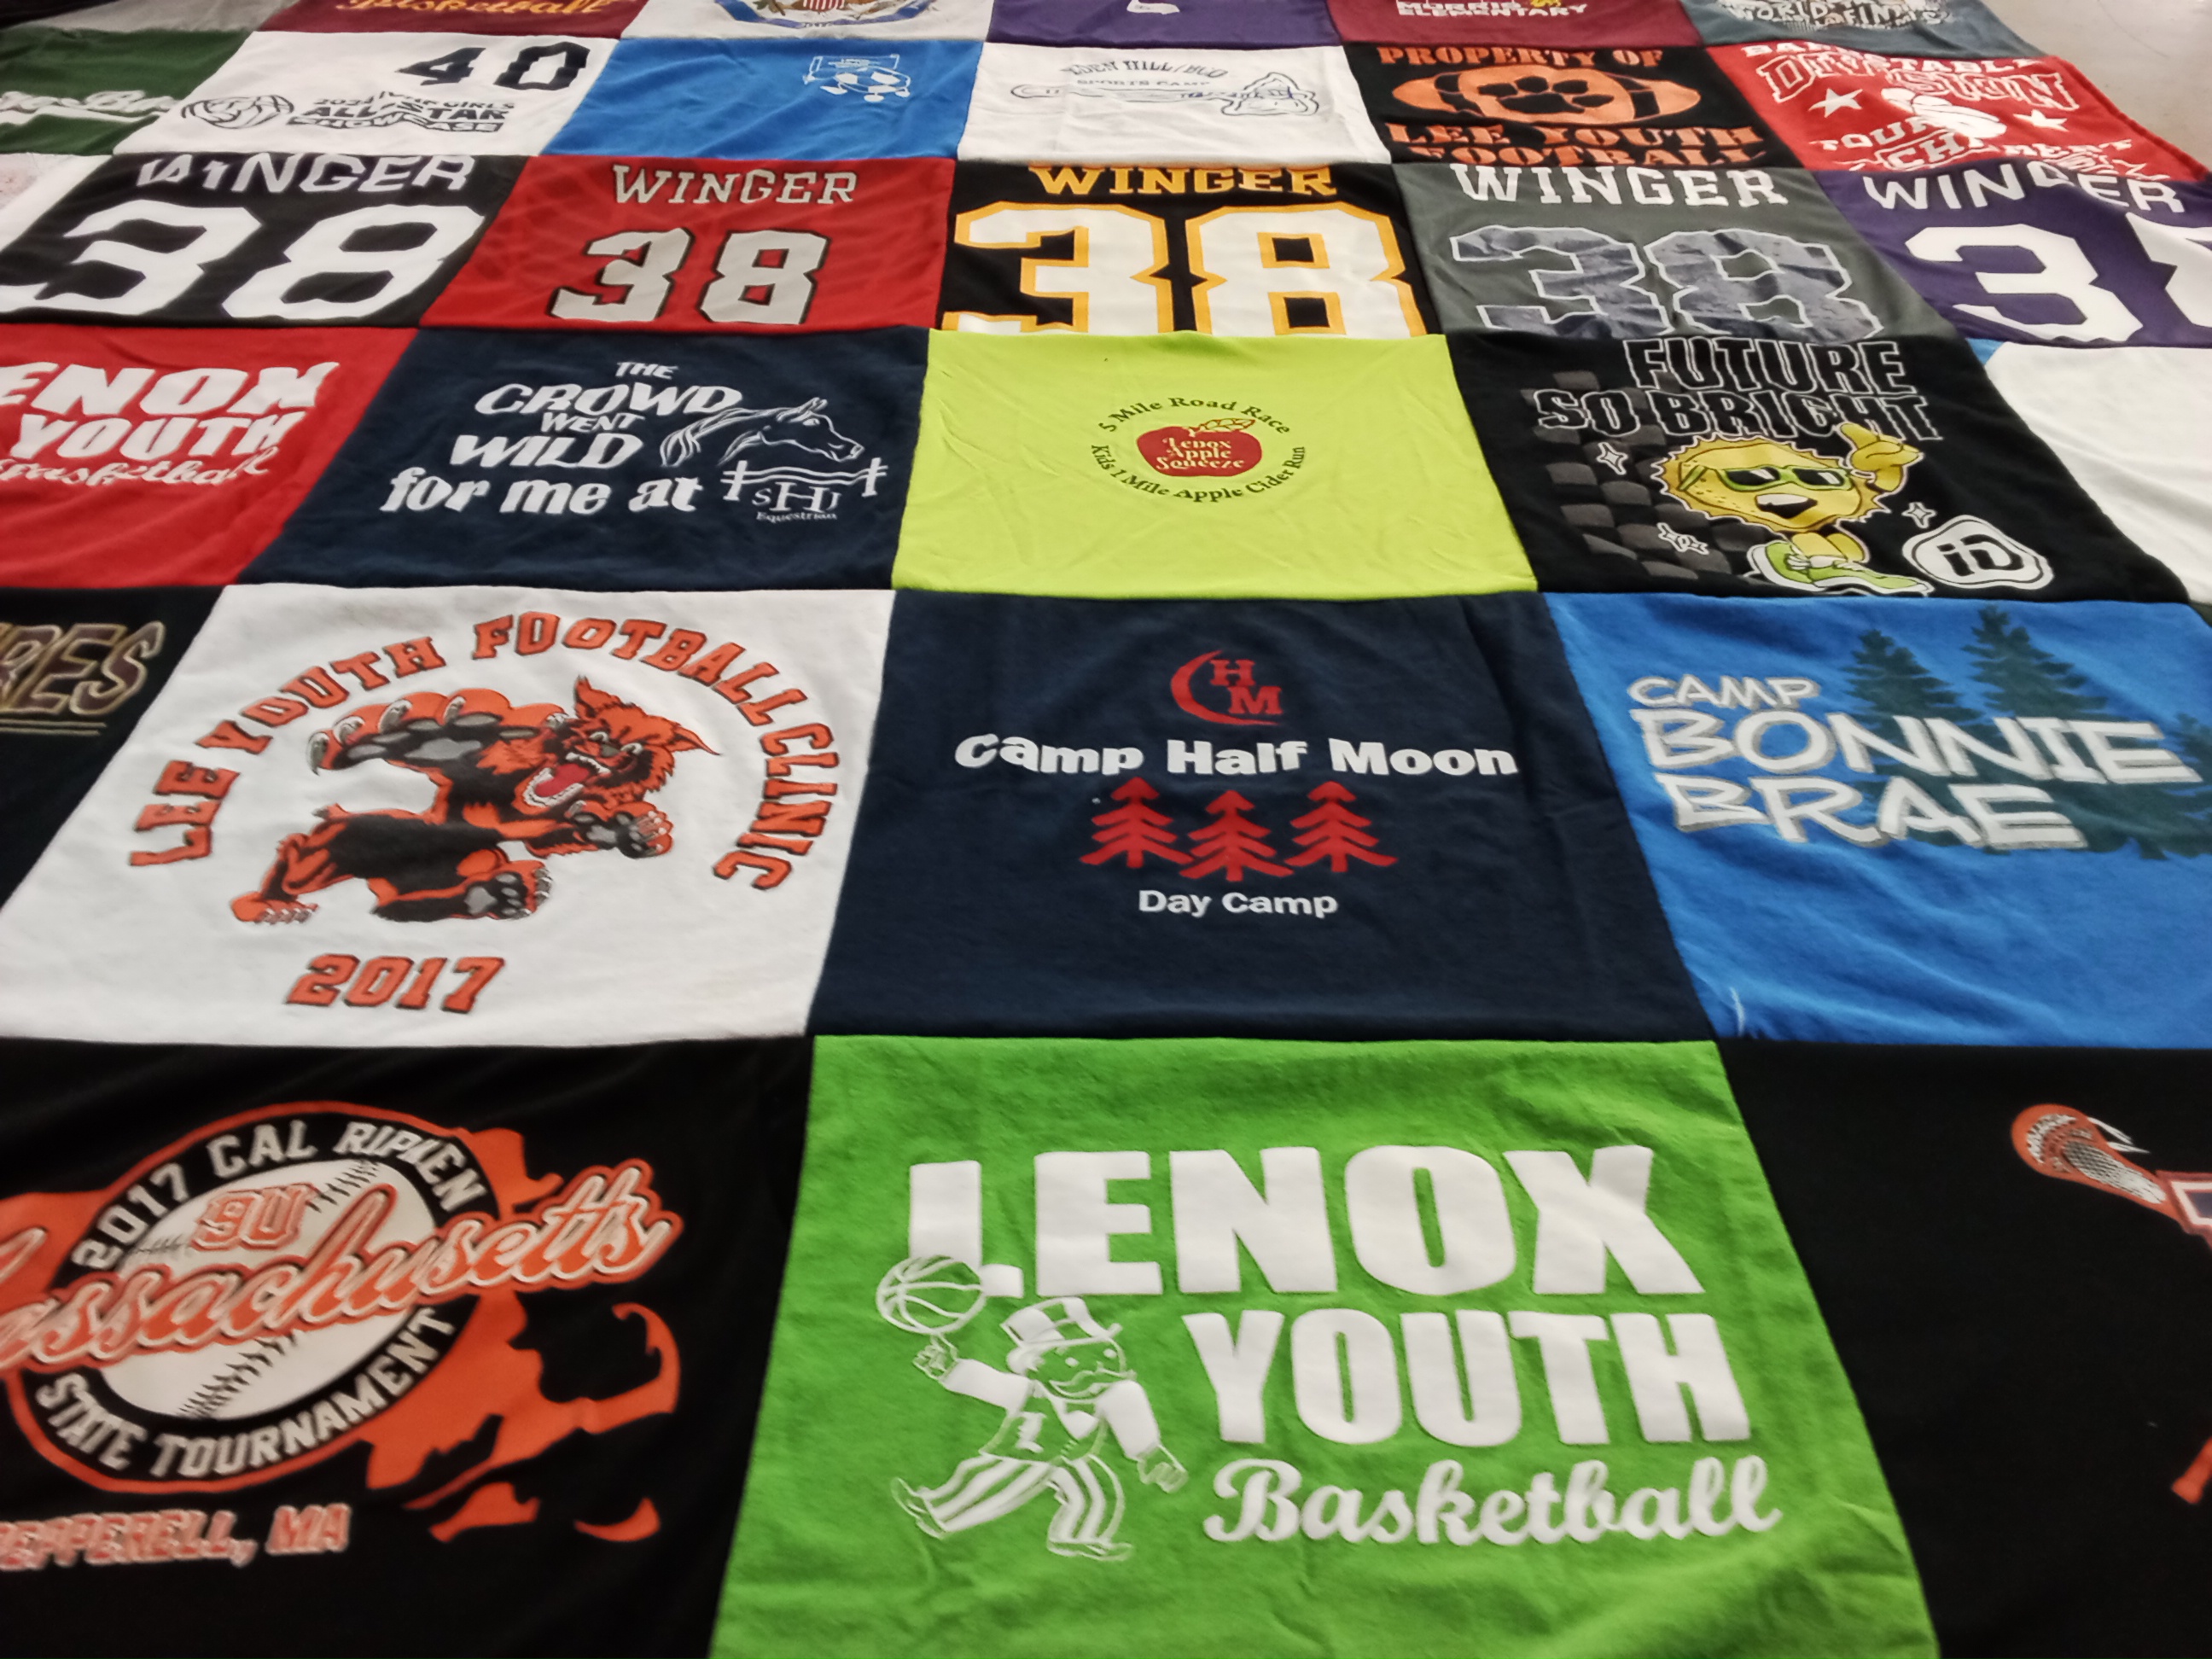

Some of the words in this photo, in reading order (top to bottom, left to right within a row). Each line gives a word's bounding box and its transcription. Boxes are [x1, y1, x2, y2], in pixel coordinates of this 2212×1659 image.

[395, 41, 591, 91] 40
[1376, 45, 1599, 67] PROPERTY
[1611, 49, 1664, 67] OF
[1384, 121, 1511, 146] LEE
[1535, 126, 1766, 148] YOUTH
[612, 164, 858, 205] WINGER
[1027, 164, 1338, 197] WINGER
[1449, 162, 1789, 207] WINGER
[549, 228, 830, 326] 38
[941, 201, 1426, 336] 38
[1449, 224, 1884, 341] 38
[0, 361, 340, 416] ENOX
[614, 360, 678, 380] THE
[1621, 337, 1918, 397] FUTURE
[474, 381, 742, 416] CROWD
[540, 410, 646, 433] WENT
[1097, 422, 1118, 433] 5
[1109, 401, 1162, 423] Mile
[1167, 397, 1237, 412] Road
[1240, 405, 1290, 434] Race
[1534, 387, 1640, 438] SO
[1644, 387, 1943, 441] BRIGHT
[9, 410, 306, 461] YOUTH
[449, 432, 643, 469] WILD
[1166, 445, 1232, 462] Apple
[1121, 474, 1169, 496] Mile
[1173, 487, 1243, 504] Apple
[1244, 469, 1294, 494] Cider
[1284, 446, 1306, 469] Run
[1155, 457, 1245, 470] Squeeze
[379, 466, 491, 513] for
[498, 479, 612, 515] me
[627, 475, 704, 514] at
[1627, 673, 1820, 712] CAMP
[130, 759, 240, 867] LEE
[196, 635, 446, 755] YOUTH
[471, 610, 809, 727] FOOTBALL
[712, 721, 839, 891] CLINIC
[953, 733, 1144, 776] Camp
[1166, 739, 1308, 776] Half
[1328, 736, 1520, 777] Moon
[1629, 708, 2203, 785] BONNIE
[1652, 771, 2088, 851] BRAE
[1138, 888, 1213, 917] Day
[1220, 890, 1339, 918] Camp
[283, 952, 505, 1014] 2017
[72, 1161, 189, 1272] 2017
[206, 1119, 318, 1180] CAL
[333, 1121, 490, 1214] RIPKEN
[908, 1144, 1705, 1298] LENOX
[0, 1157, 684, 1376] assachusetts
[35, 1372, 148, 1472] STATE
[150, 1306, 458, 1480] TOURNAMENT
[1181, 1307, 1752, 1449] YOUTH
[1202, 1452, 1782, 1547] Basketball
[265, 1503, 352, 1557] MA
